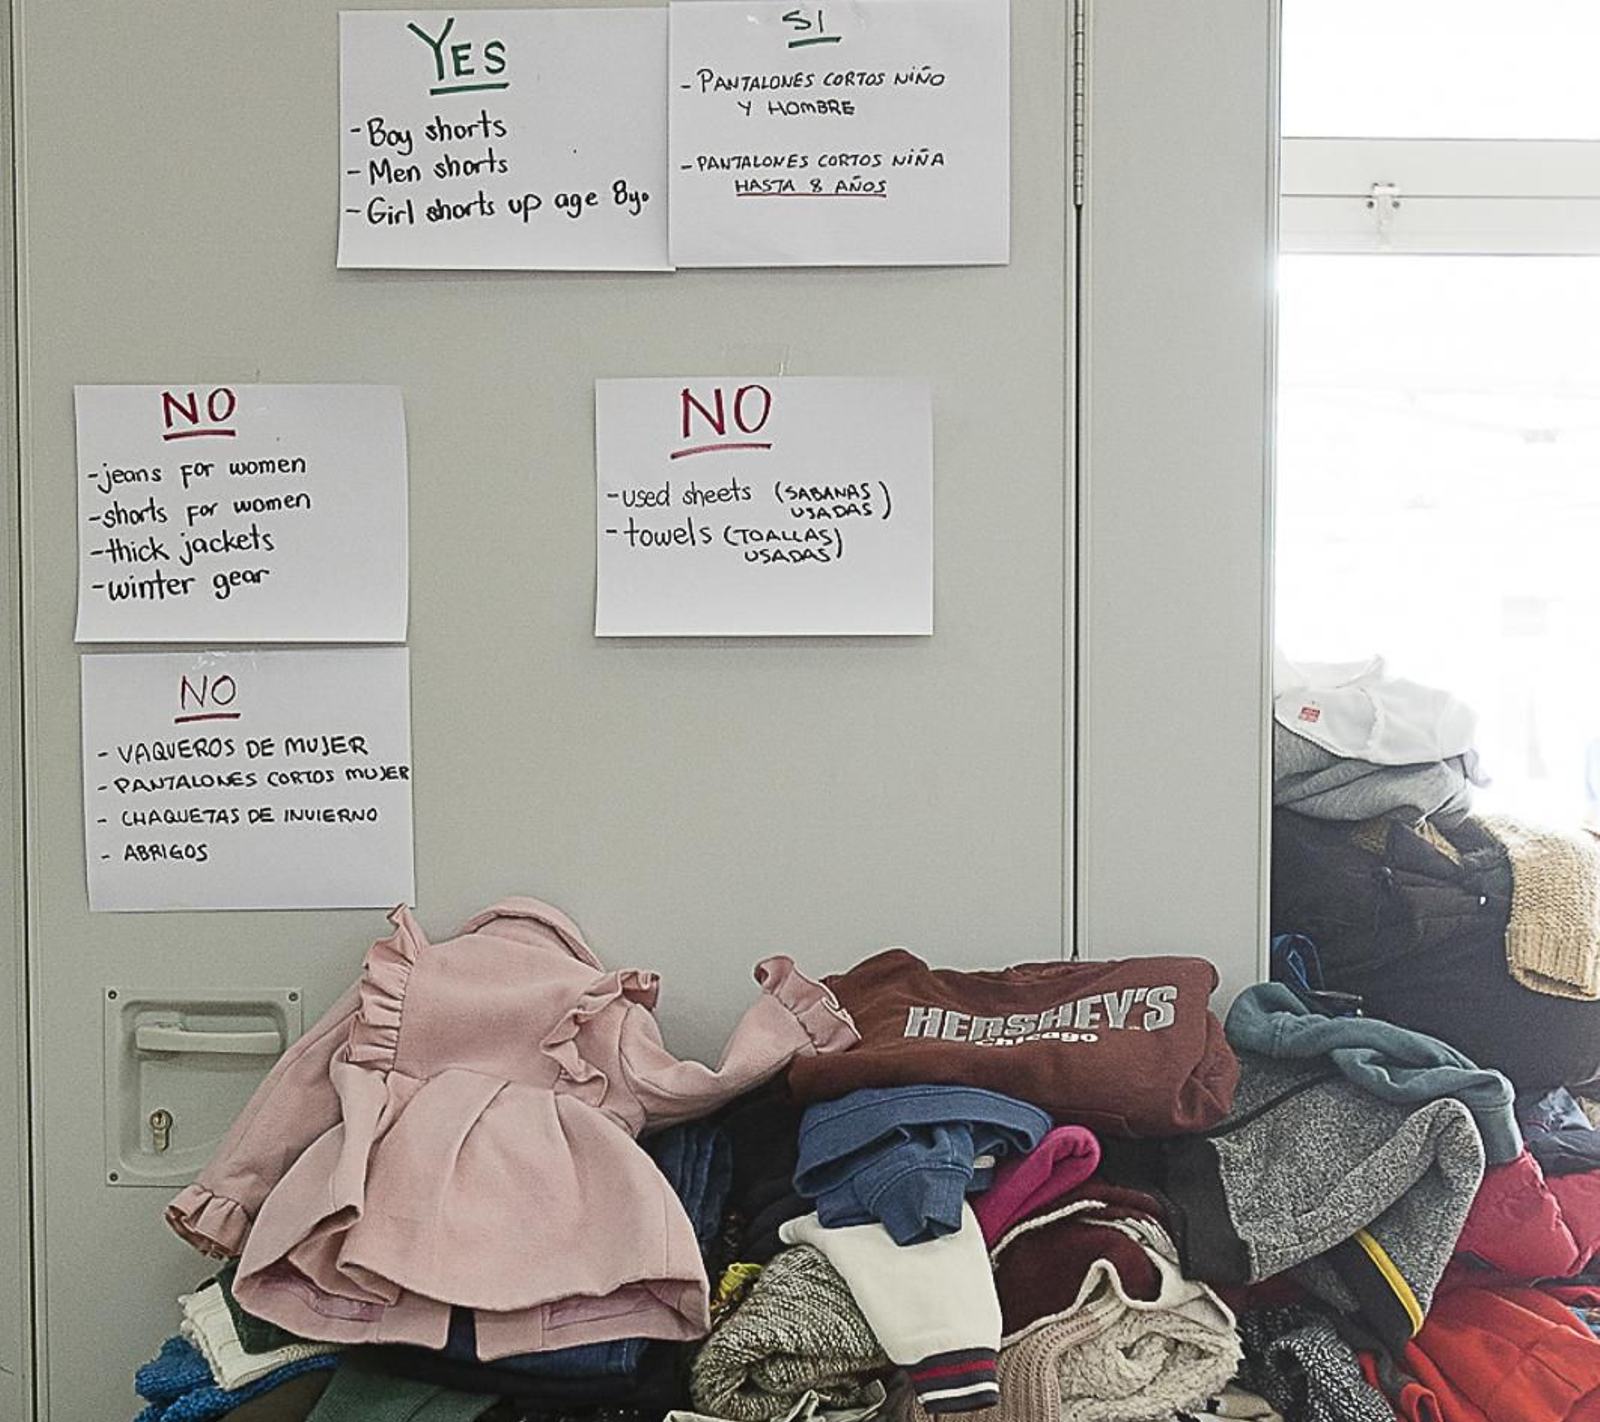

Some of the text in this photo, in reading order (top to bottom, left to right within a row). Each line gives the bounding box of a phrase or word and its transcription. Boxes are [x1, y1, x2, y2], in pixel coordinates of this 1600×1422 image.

[782, 10, 824, 33] SI
[407, 17, 506, 82] YES
[823, 73, 884, 87] CORTOS
[738, 101, 751, 116] Y
[425, 110, 507, 142] shorts
[434, 147, 508, 179] shorts
[818, 154, 882, 168] CORTOS
[735, 176, 887, 194] HASTA 8 AÑOS
[426, 191, 495, 223] shorts
[508, 194, 542, 223] up
[555, 191, 598, 218] age
[161, 387, 236, 428] NO
[681, 384, 771, 437] NO
[229, 457, 306, 476] women
[234, 492, 311, 513] women
[682, 477, 751, 507] sheets
[179, 524, 275, 566] jackets
[213, 567, 270, 599] gear
[181, 675, 236, 710] NO
[118, 738, 235, 764] VAQUEROS
[246, 738, 275, 759] DE
[285, 735, 369, 757] MUJER
[114, 772, 257, 793] PANTALONES
[268, 770, 334, 786] CORTOS
[346, 766, 410, 782] MUJER
[122, 808, 239, 826] CHAQUETAS
[248, 808, 275, 823] DE
[124, 844, 208, 862] ABRIGOS
[903, 985, 1179, 1043] HERSHEY'S
